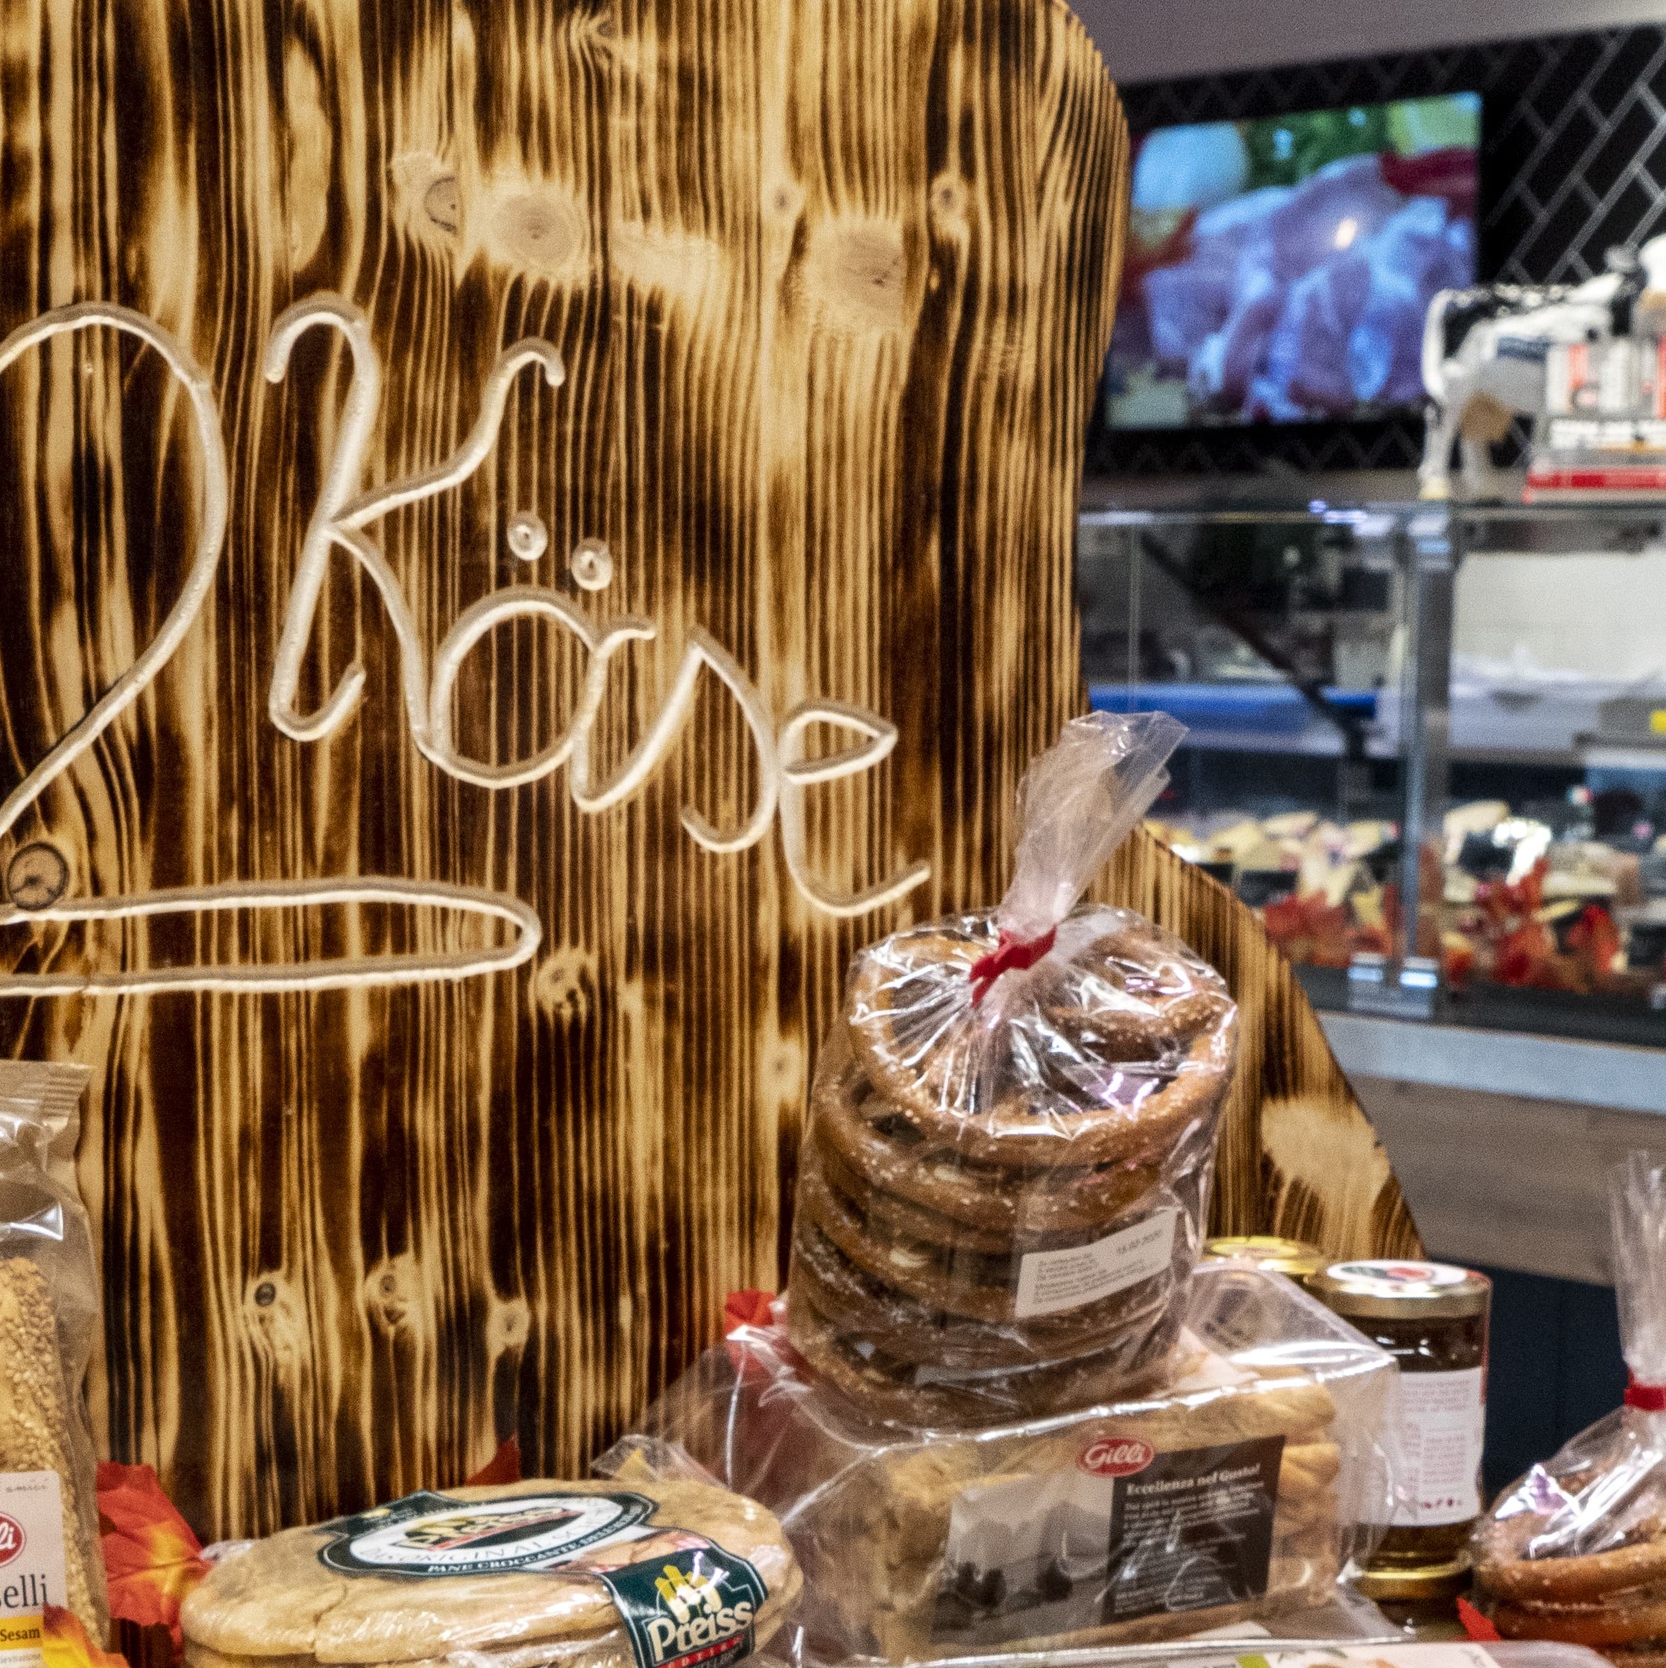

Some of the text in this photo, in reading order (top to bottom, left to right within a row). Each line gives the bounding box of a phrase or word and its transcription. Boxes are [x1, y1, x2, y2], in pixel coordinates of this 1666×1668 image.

[265, 292, 929, 918] Käse
[1084, 1442, 1145, 1470] Gilli
[0, 1627, 40, 1641] Sesam
[647, 1601, 753, 1662] Preiss
